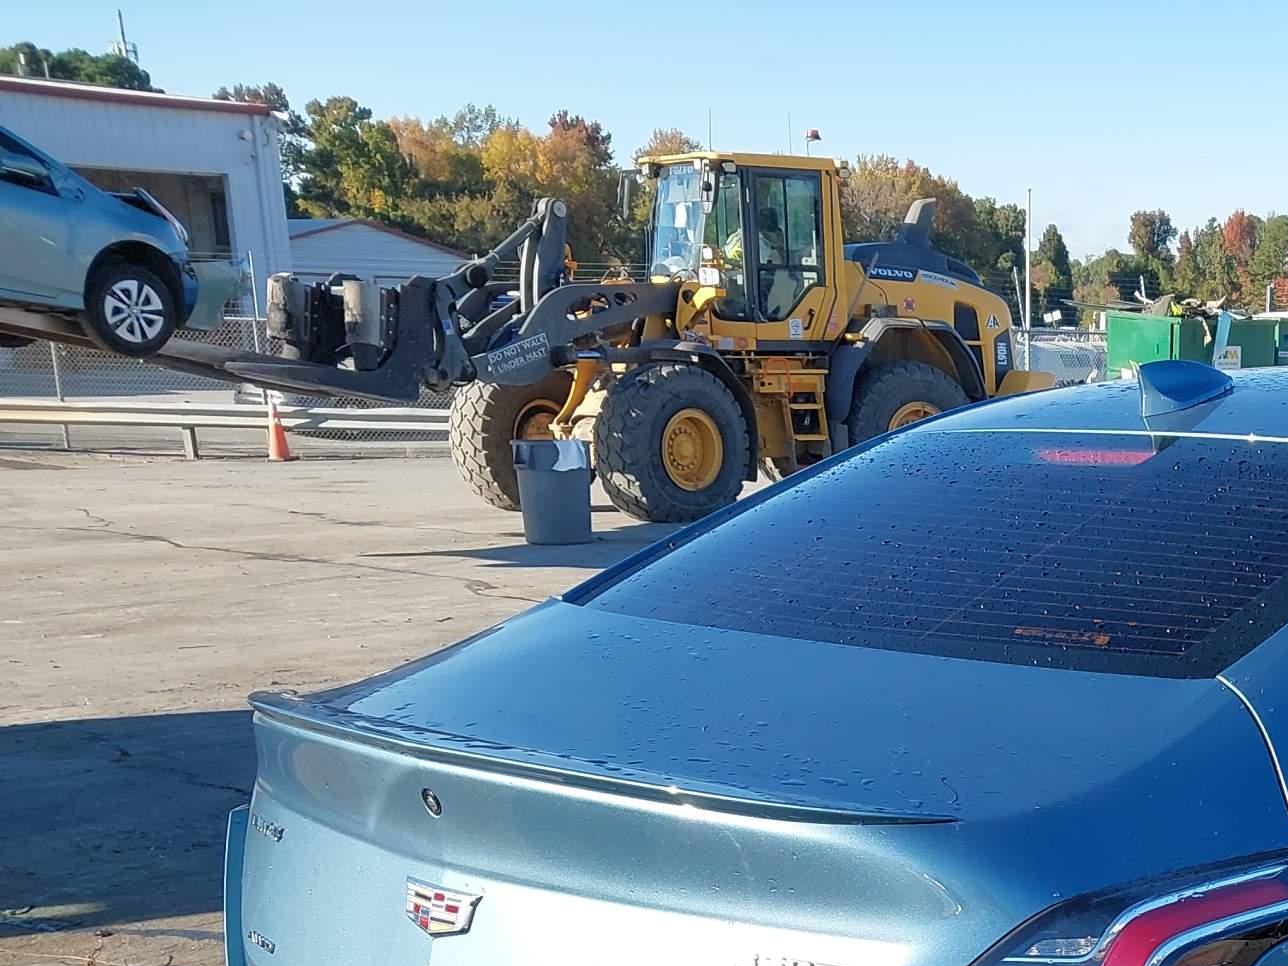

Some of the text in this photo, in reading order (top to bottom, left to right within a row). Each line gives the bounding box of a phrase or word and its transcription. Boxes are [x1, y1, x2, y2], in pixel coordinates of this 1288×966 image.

[868, 267, 913, 279] VOLVO
[489, 335, 546, 363] DO NOT WALK
[497, 347, 546, 373] UNDER MAST
[997, 342, 1008, 366] L90H
